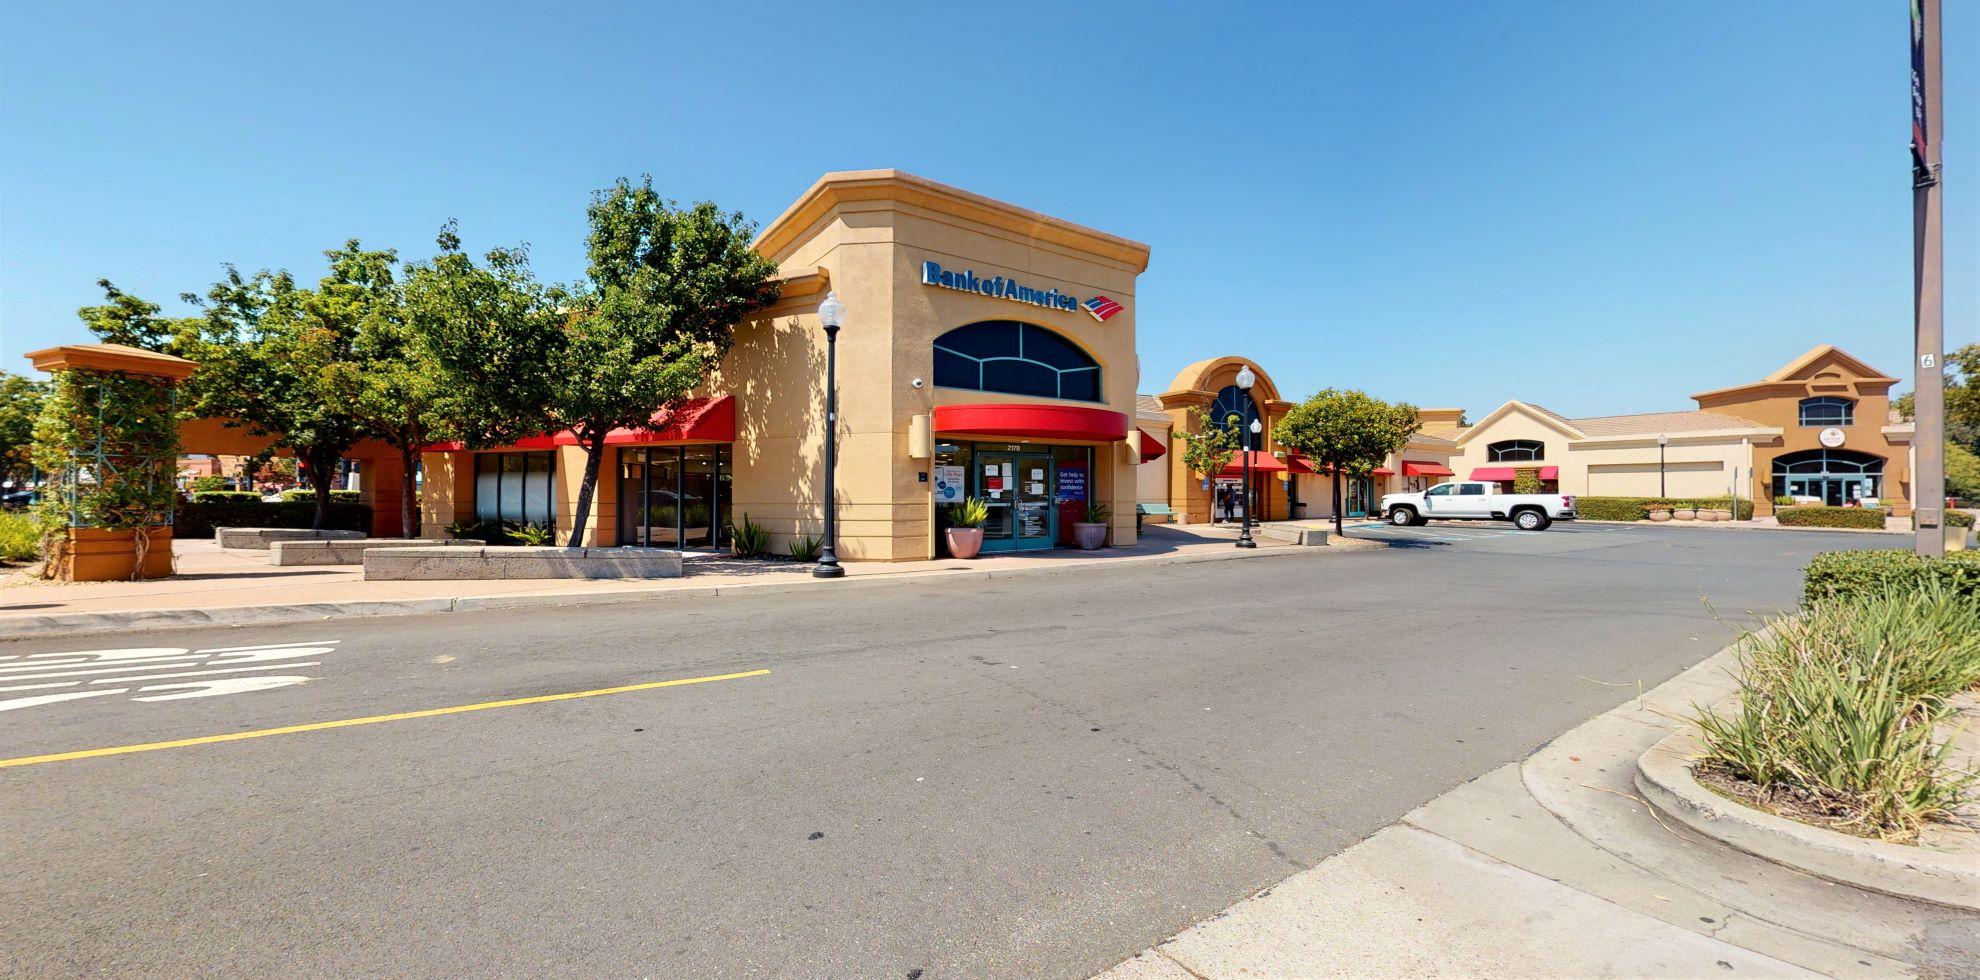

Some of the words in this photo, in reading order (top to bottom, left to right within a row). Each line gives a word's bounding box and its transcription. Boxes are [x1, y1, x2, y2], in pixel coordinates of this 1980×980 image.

[922, 261, 979, 293] Bank
[978, 275, 1002, 298] of
[1001, 278, 1078, 312] America
[1923, 355, 1932, 367] 6
[1007, 444, 1020, 452] 2178
[1069, 471, 1078, 479] help
